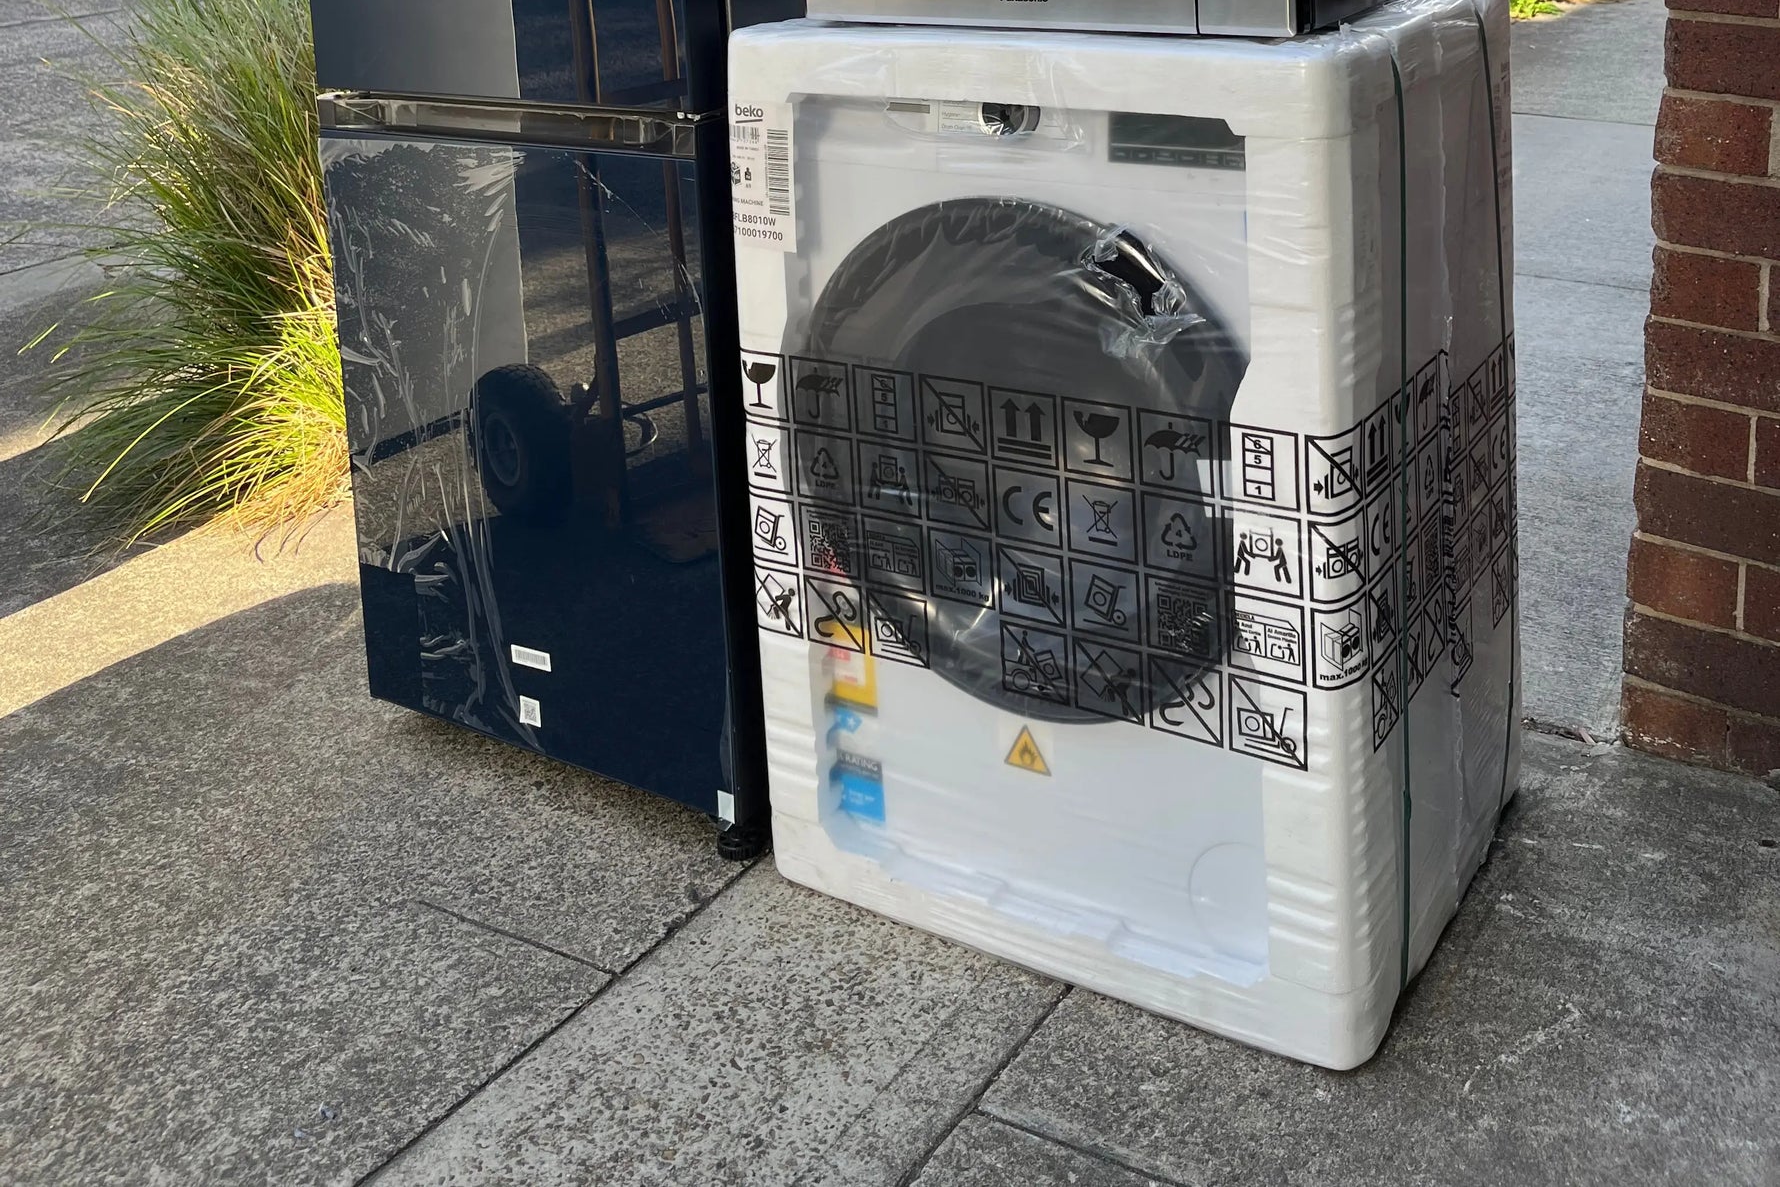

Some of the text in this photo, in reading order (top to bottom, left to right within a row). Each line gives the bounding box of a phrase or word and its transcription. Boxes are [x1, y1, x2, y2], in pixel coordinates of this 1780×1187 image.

[735, 104, 763, 118] beko
[741, 198, 764, 207] MACHINE
[1254, 454, 1262, 464] 5
[1255, 485, 1262, 494] 1
[1166, 549, 1194, 562] LDPE
[1320, 662, 1361, 681] max.1000
[844, 753, 878, 772] RATING
